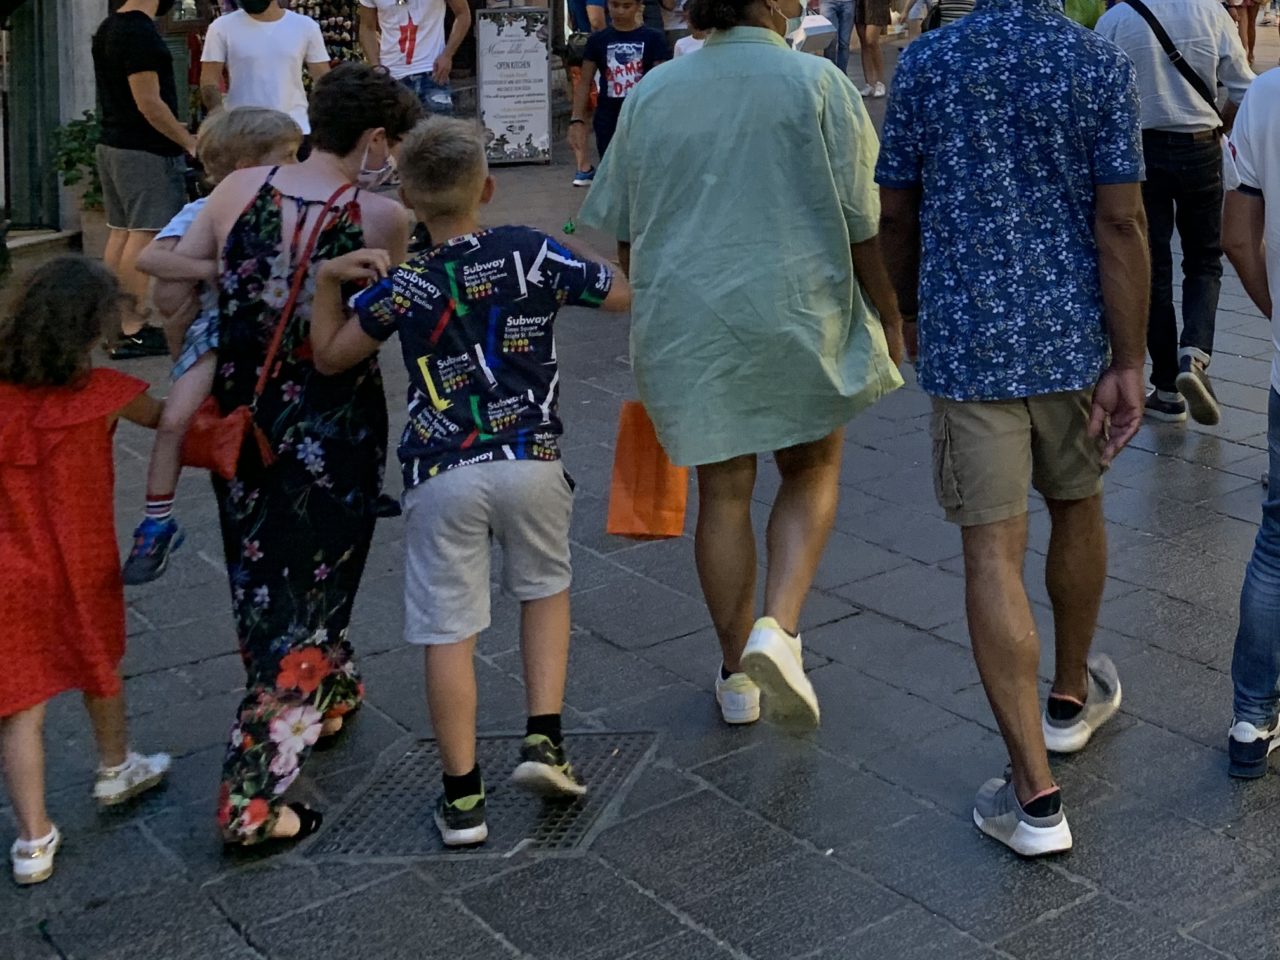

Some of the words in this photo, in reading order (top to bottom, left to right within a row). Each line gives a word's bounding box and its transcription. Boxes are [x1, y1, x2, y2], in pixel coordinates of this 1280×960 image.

[510, 60, 531, 69] KITCHEN
[463, 258, 505, 275] Subway
[396, 268, 442, 299] Subway
[506, 314, 549, 326] Subway
[437, 352, 469, 369] Subwa
